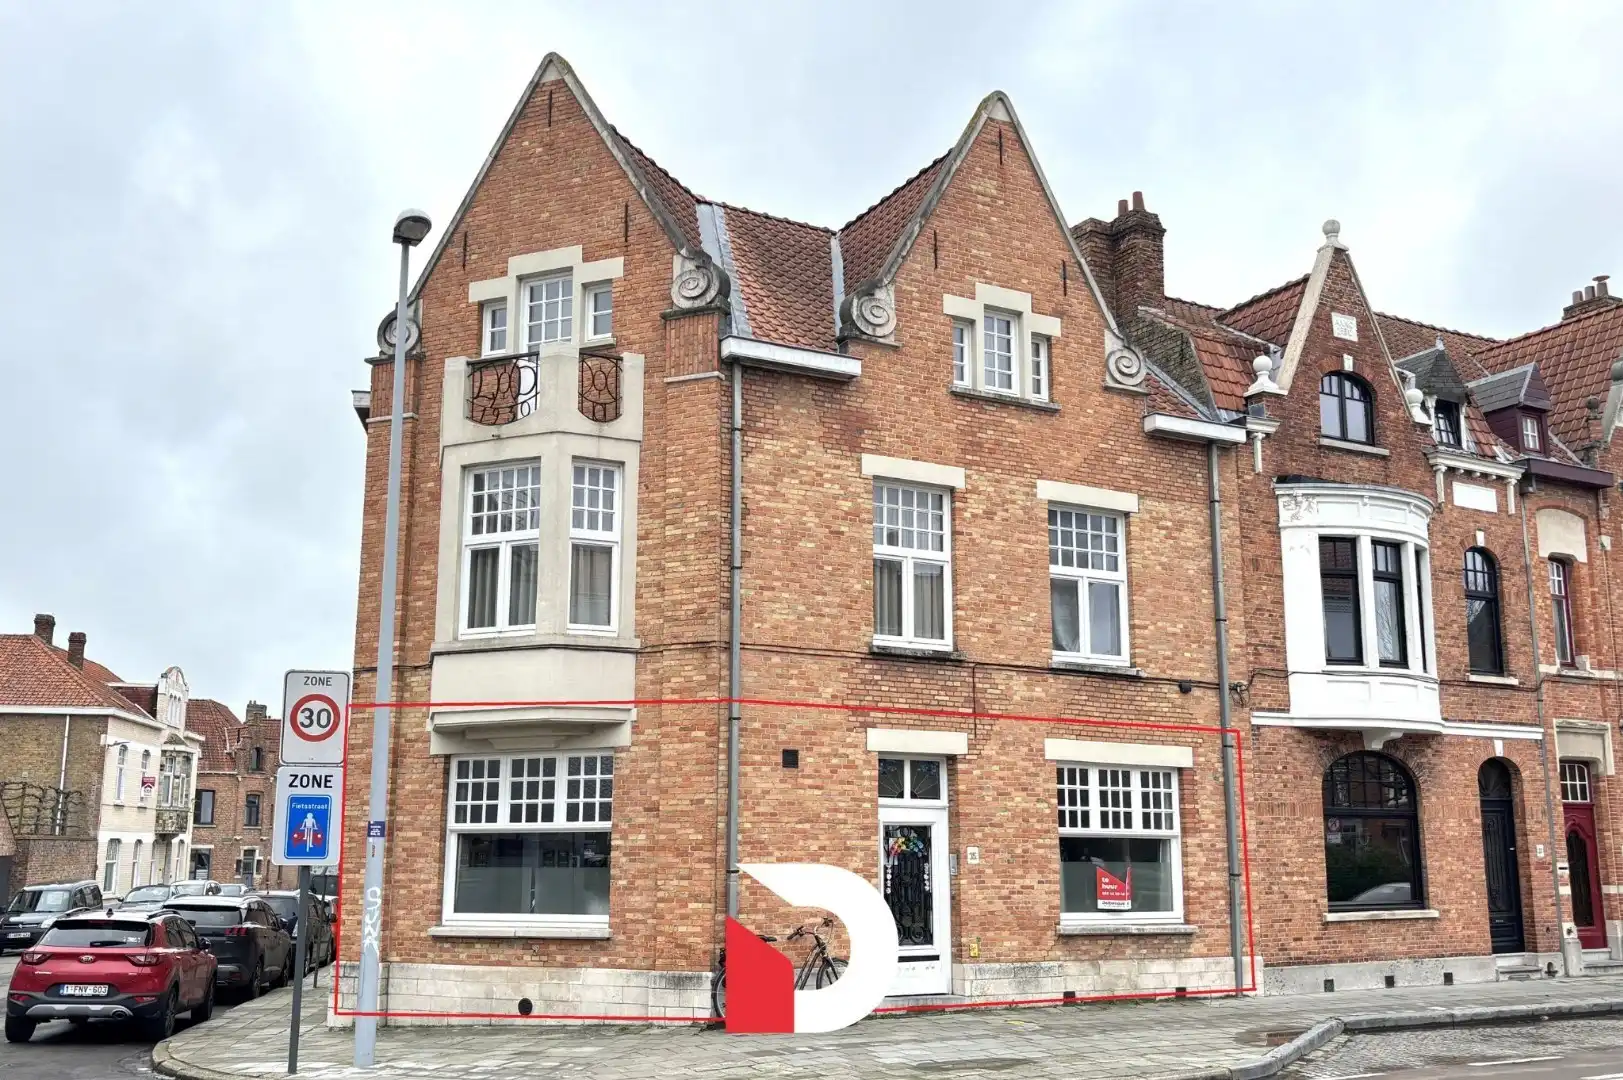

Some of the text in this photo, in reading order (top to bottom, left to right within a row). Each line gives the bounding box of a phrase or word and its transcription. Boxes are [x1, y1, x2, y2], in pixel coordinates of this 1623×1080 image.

[303, 676, 333, 687] ZONE
[299, 707, 332, 729] 30
[288, 774, 334, 789] ZONE
[291, 802, 329, 810] Fietsstraat
